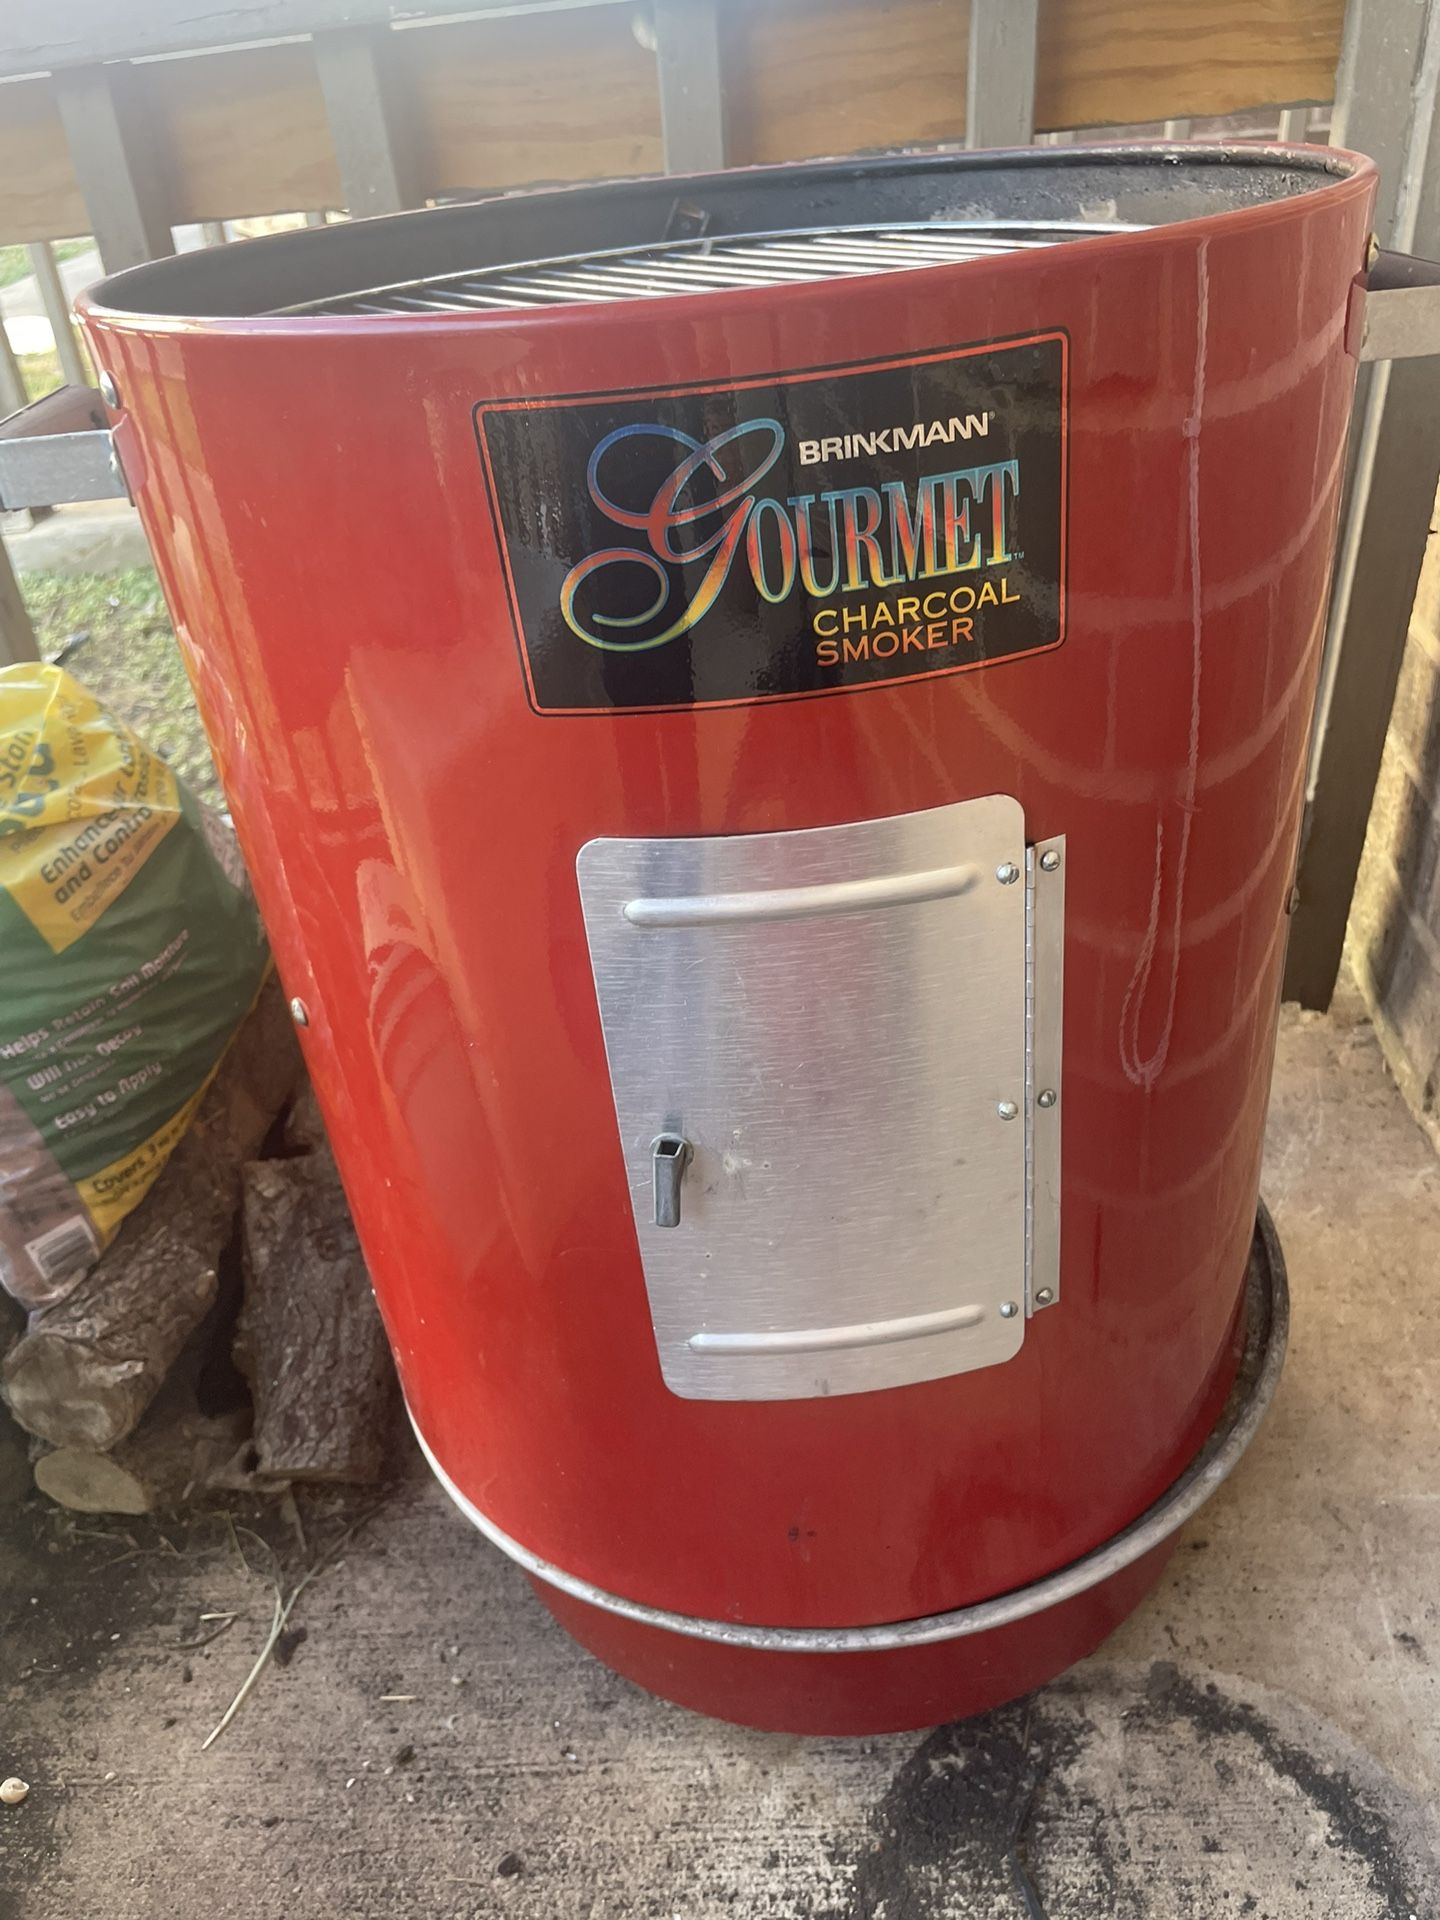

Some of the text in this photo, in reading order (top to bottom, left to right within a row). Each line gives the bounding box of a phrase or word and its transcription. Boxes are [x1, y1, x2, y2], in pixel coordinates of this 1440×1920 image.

[798, 411, 989, 466] BRINKMANN
[812, 577, 1021, 638] CHARCOAL
[815, 617, 974, 668] SMOKER
[53, 865, 93, 905] and
[0, 929, 189, 1061] Helps Retain Soil Moisture
[26, 1064, 63, 1091] Will
[54, 1105, 98, 1130] Easy
[97, 1086, 118, 1104] to
[118, 1060, 163, 1095] Apply
[92, 1155, 147, 1194] Covers
